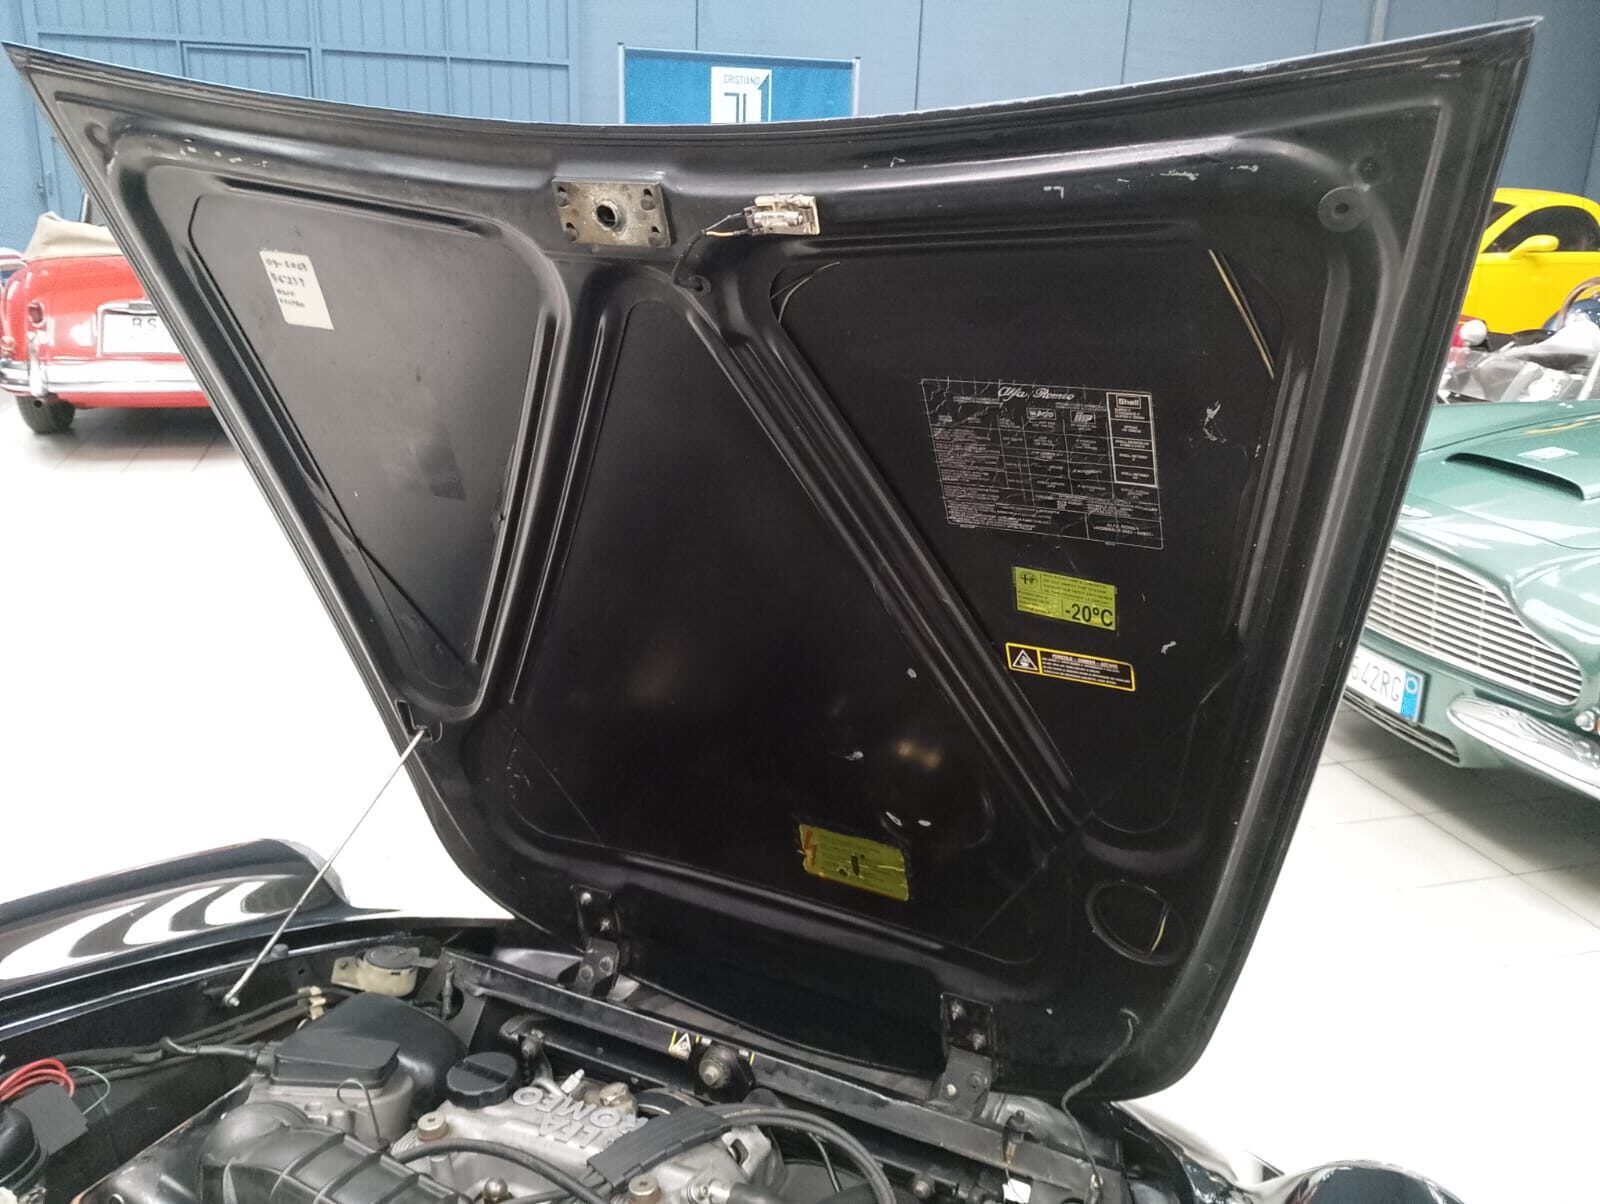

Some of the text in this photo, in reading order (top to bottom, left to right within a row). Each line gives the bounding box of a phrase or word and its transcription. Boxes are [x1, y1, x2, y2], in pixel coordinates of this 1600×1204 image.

[723, 74, 760, 85] CRISTIANO
[998, 386, 1028, 402] Alfa
[1032, 387, 1075, 401] Romeo
[1118, 397, 1139, 406] Shell
[1065, 603, 1113, 627] -20°C
